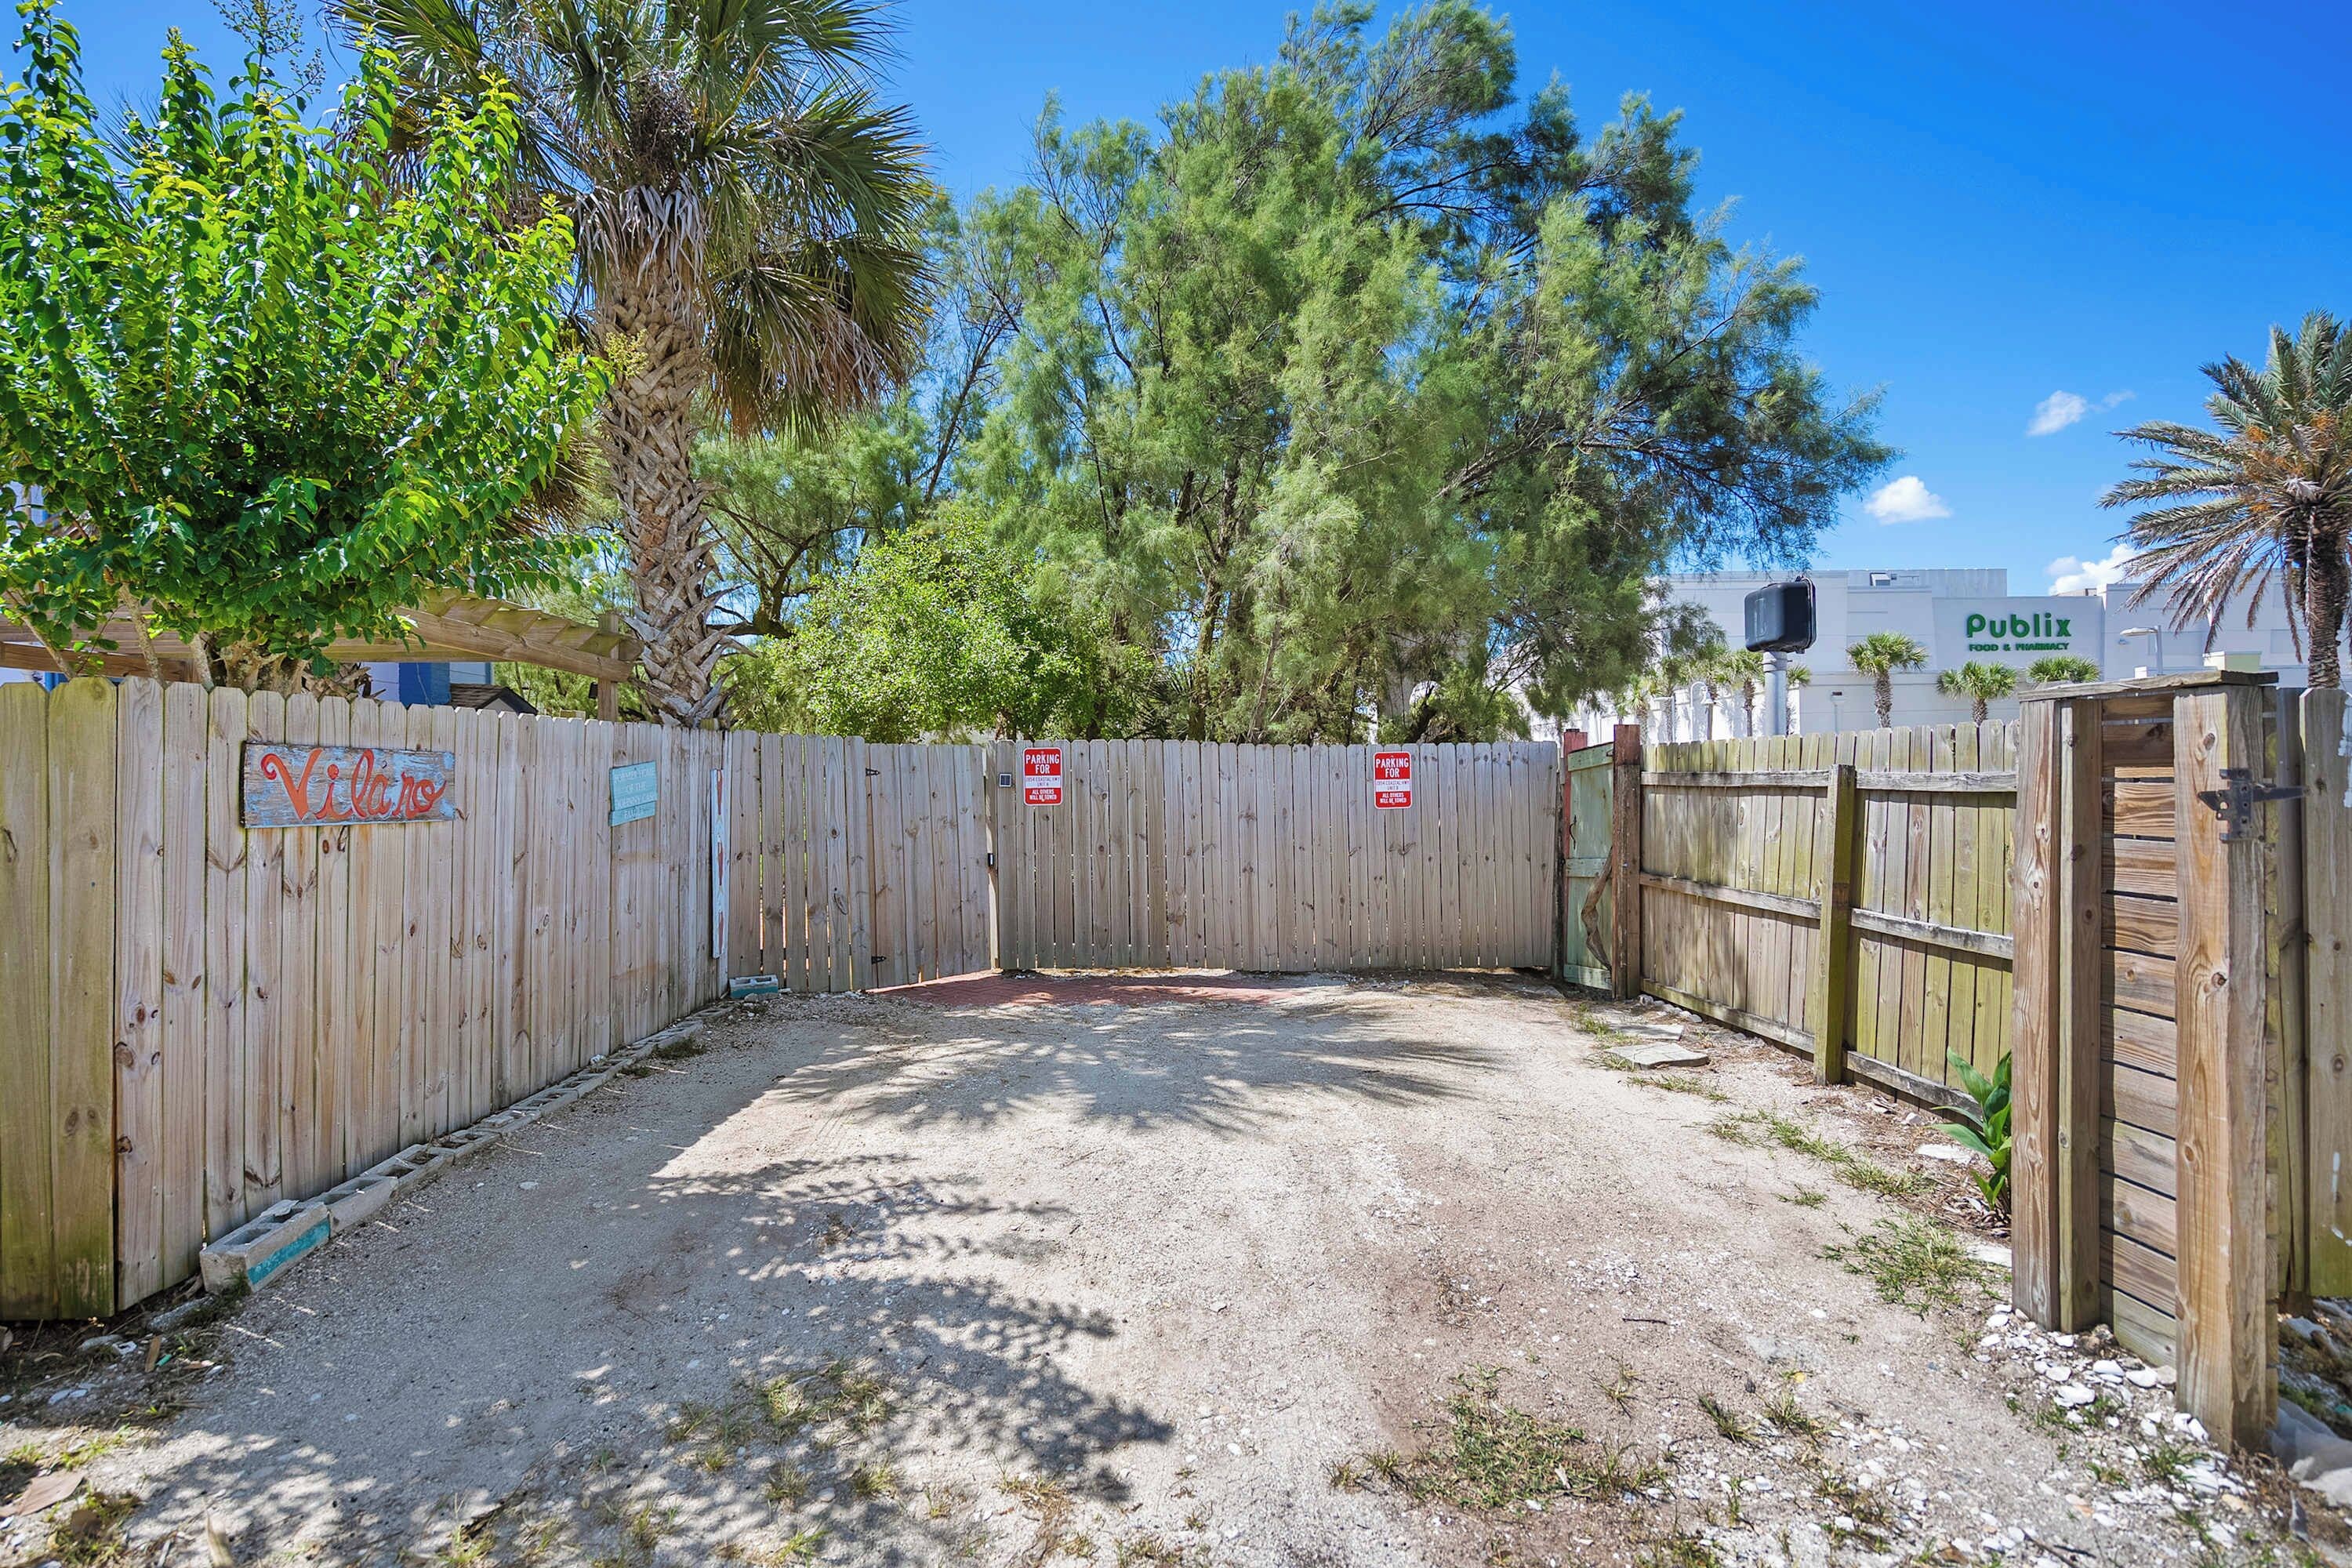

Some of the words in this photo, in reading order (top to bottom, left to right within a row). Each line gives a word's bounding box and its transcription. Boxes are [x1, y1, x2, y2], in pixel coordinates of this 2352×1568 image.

[1966, 612, 2071, 638] Publix
[2016, 642, 2070, 652] PHARMACY
[1025, 753, 1060, 764] PARKING
[1375, 757, 1409, 768] PARKING
[1035, 764, 1051, 774] FOR
[1385, 768, 1399, 778] FOR
[260, 748, 447, 821] Vilano
